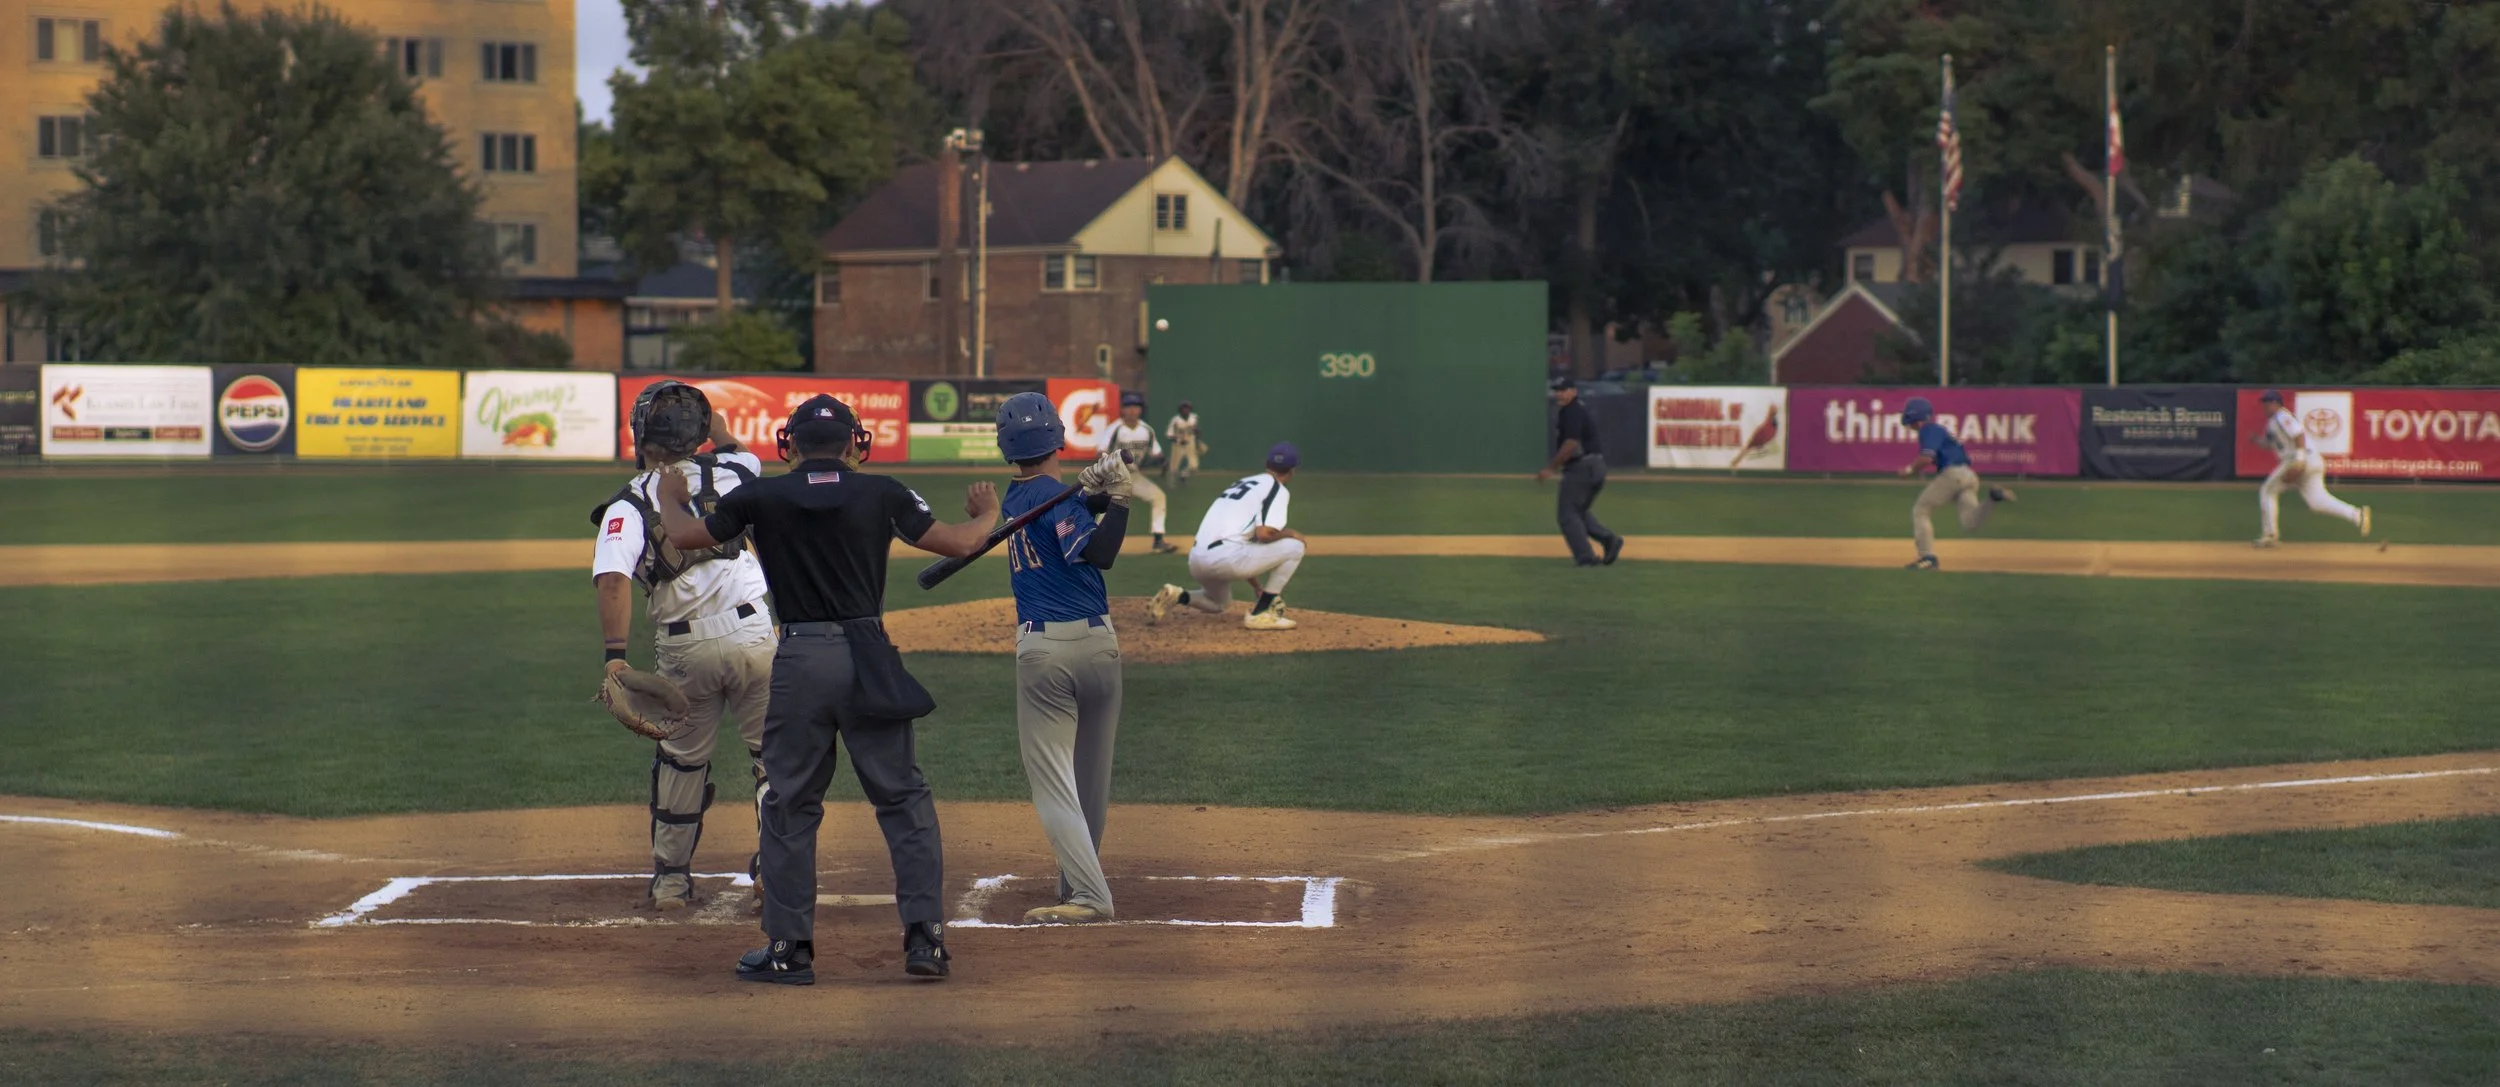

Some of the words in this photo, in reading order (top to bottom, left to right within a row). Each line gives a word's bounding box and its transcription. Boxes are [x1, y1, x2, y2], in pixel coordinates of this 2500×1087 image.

[1320, 353, 1375, 378] 390
[225, 403, 284, 419] PEPSI
[1058, 388, 1107, 450] G
[1824, 398, 1919, 442] thin
[2174, 407, 2224, 427] Braun
[2363, 408, 2500, 441] TOYOTA
[2324, 458, 2481, 474] ochestertoyota.com
